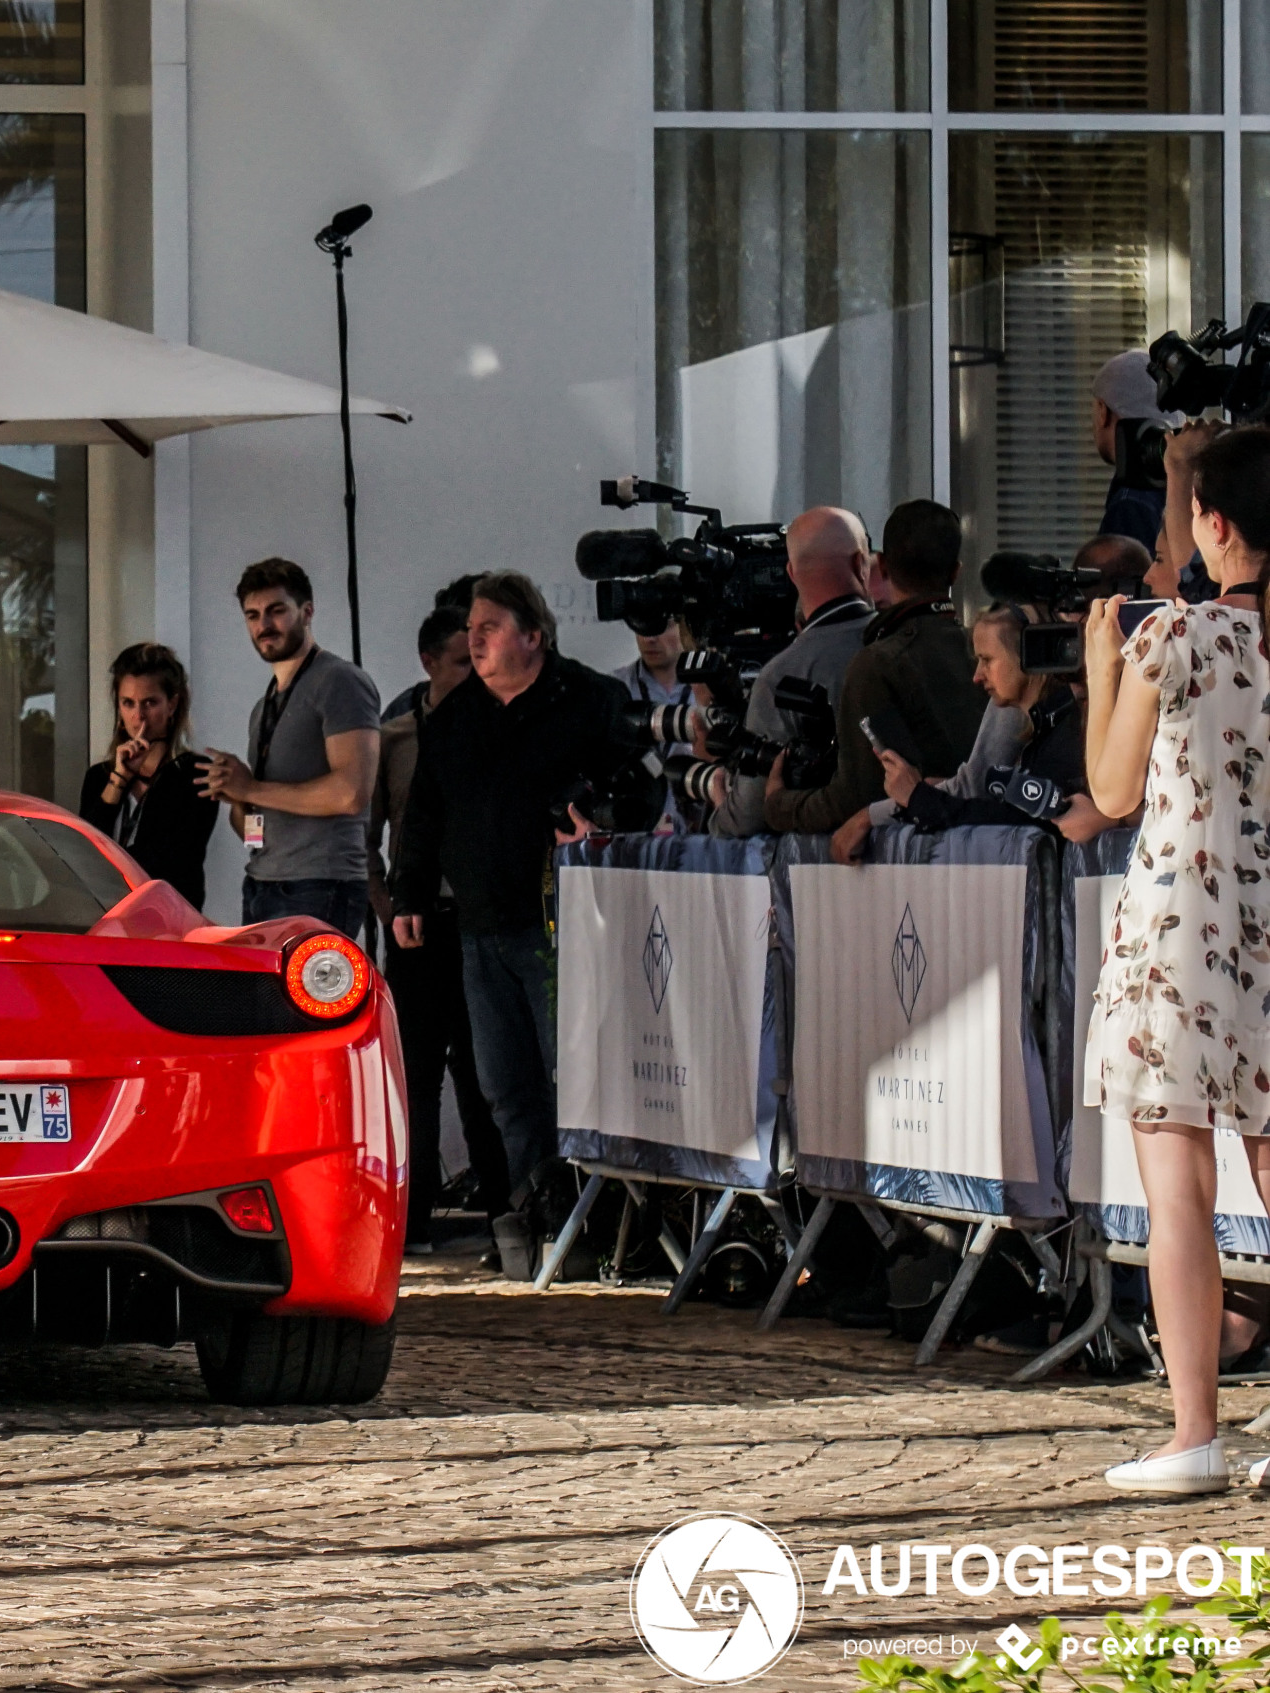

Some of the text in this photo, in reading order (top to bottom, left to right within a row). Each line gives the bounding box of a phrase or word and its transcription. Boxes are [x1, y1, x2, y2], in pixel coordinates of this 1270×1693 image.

[633, 1060, 687, 1087] MARTINEZ
[877, 1075, 944, 1104] MARTINEZ
[43, 1117, 67, 1137] 75
[891, 1117, 928, 1133] CANNES
